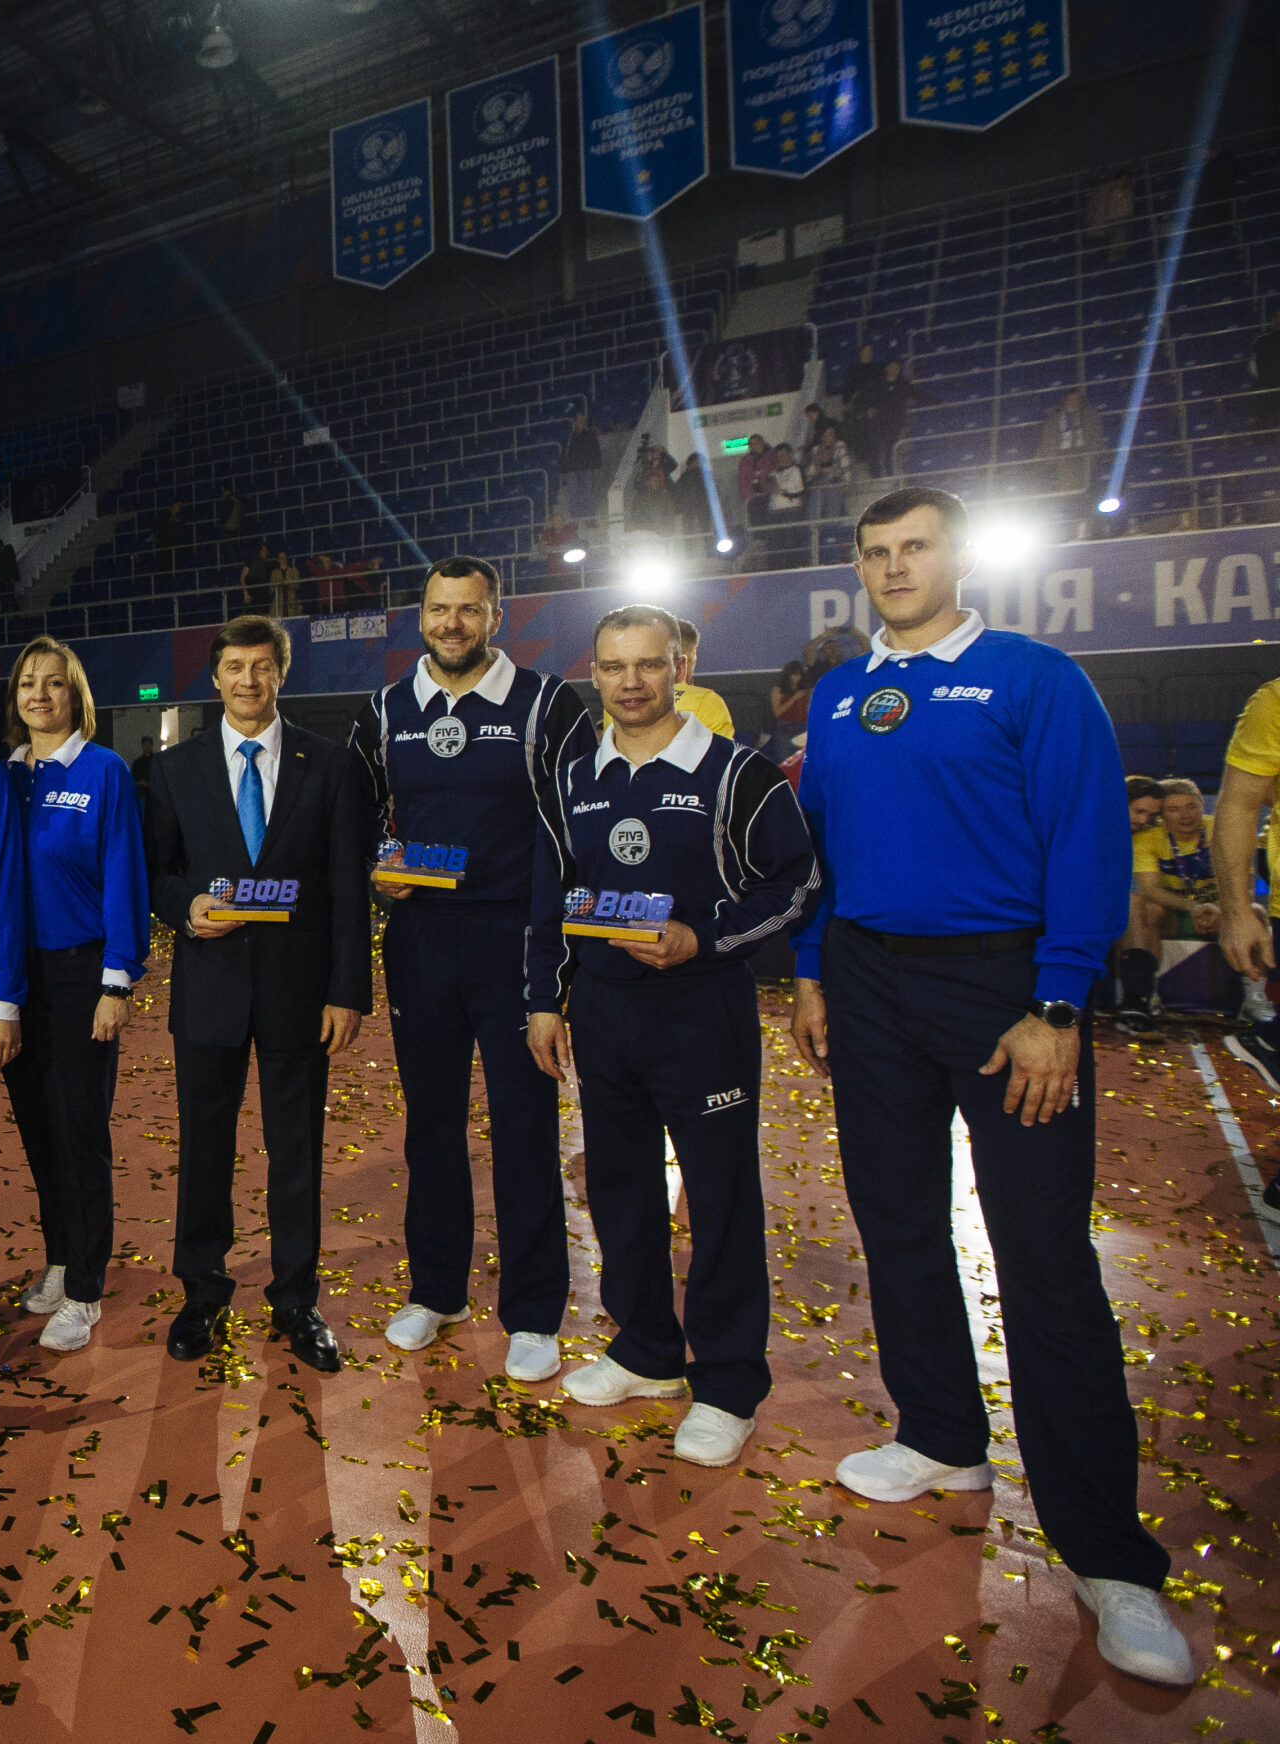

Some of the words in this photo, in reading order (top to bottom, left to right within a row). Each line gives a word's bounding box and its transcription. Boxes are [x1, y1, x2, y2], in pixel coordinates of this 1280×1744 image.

[926, 0, 1025, 29] ЧЕМПИ
[937, 4, 1027, 43] РОССИИ
[742, 37, 859, 83] ПОБЕДИТЕЛЬ
[744, 64, 858, 107] ЧЕМПИОНОВ
[775, 62, 825, 88] ЛИГИ
[591, 91, 694, 132] ПОБЕДИТЕЛЬ
[601, 105, 684, 141] КЛУБНОГО
[589, 115, 696, 156] ЧЕМПИОНАТА
[459, 135, 550, 171] ОБЛАДАТЕЛЬ
[620, 138, 665, 161] МИРА
[477, 164, 532, 189] РОССИИ
[481, 154, 527, 176] КУБКА
[341, 175, 424, 208] ОБЛАДАТЕЛЬ
[342, 187, 422, 219] СУПЕРКУБКА
[357, 202, 407, 225] РОССИИ
[809, 566, 1095, 640] РИЯ
[1154, 551, 1280, 627] КА
[948, 686, 994, 701] ВФВ
[435, 727, 460, 738] FIVB
[479, 725, 513, 736] FIVB
[55, 791, 91, 808] ВФВ
[661, 793, 700, 807] FIVB
[618, 831, 644, 842] FIVB
[404, 842, 468, 872] ВФВ
[234, 878, 299, 903] ВФВ
[594, 890, 675, 923] ВФВ
[706, 1087, 742, 1108] FIVB
